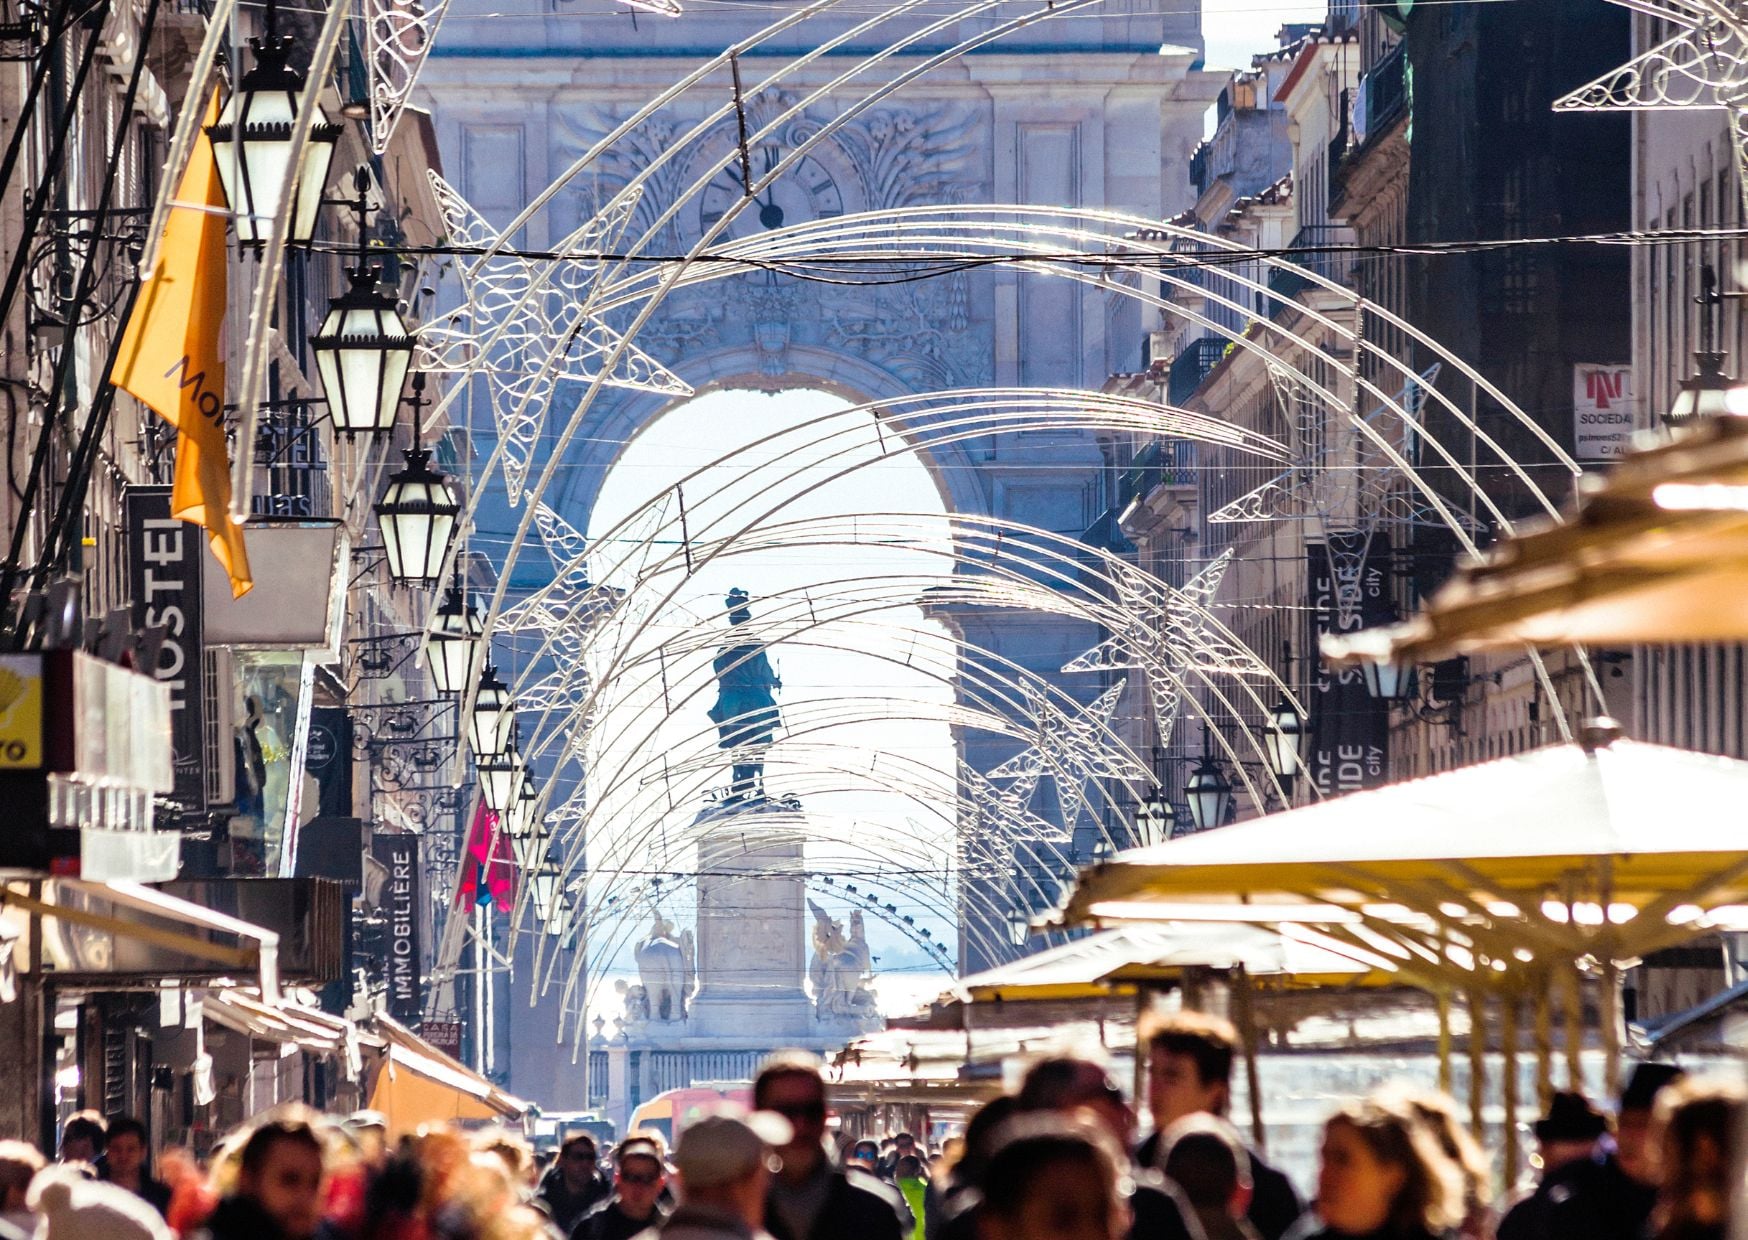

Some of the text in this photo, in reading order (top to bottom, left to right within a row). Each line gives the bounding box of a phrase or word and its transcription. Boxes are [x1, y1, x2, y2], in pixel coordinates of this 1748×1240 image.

[1580, 413, 1633, 425] SOCIEDA
[1366, 567, 1383, 598] city
[1338, 745, 1363, 790] IDE
[1366, 746, 1383, 776] city
[389, 851, 412, 1000] IMMOBILIÈRE
